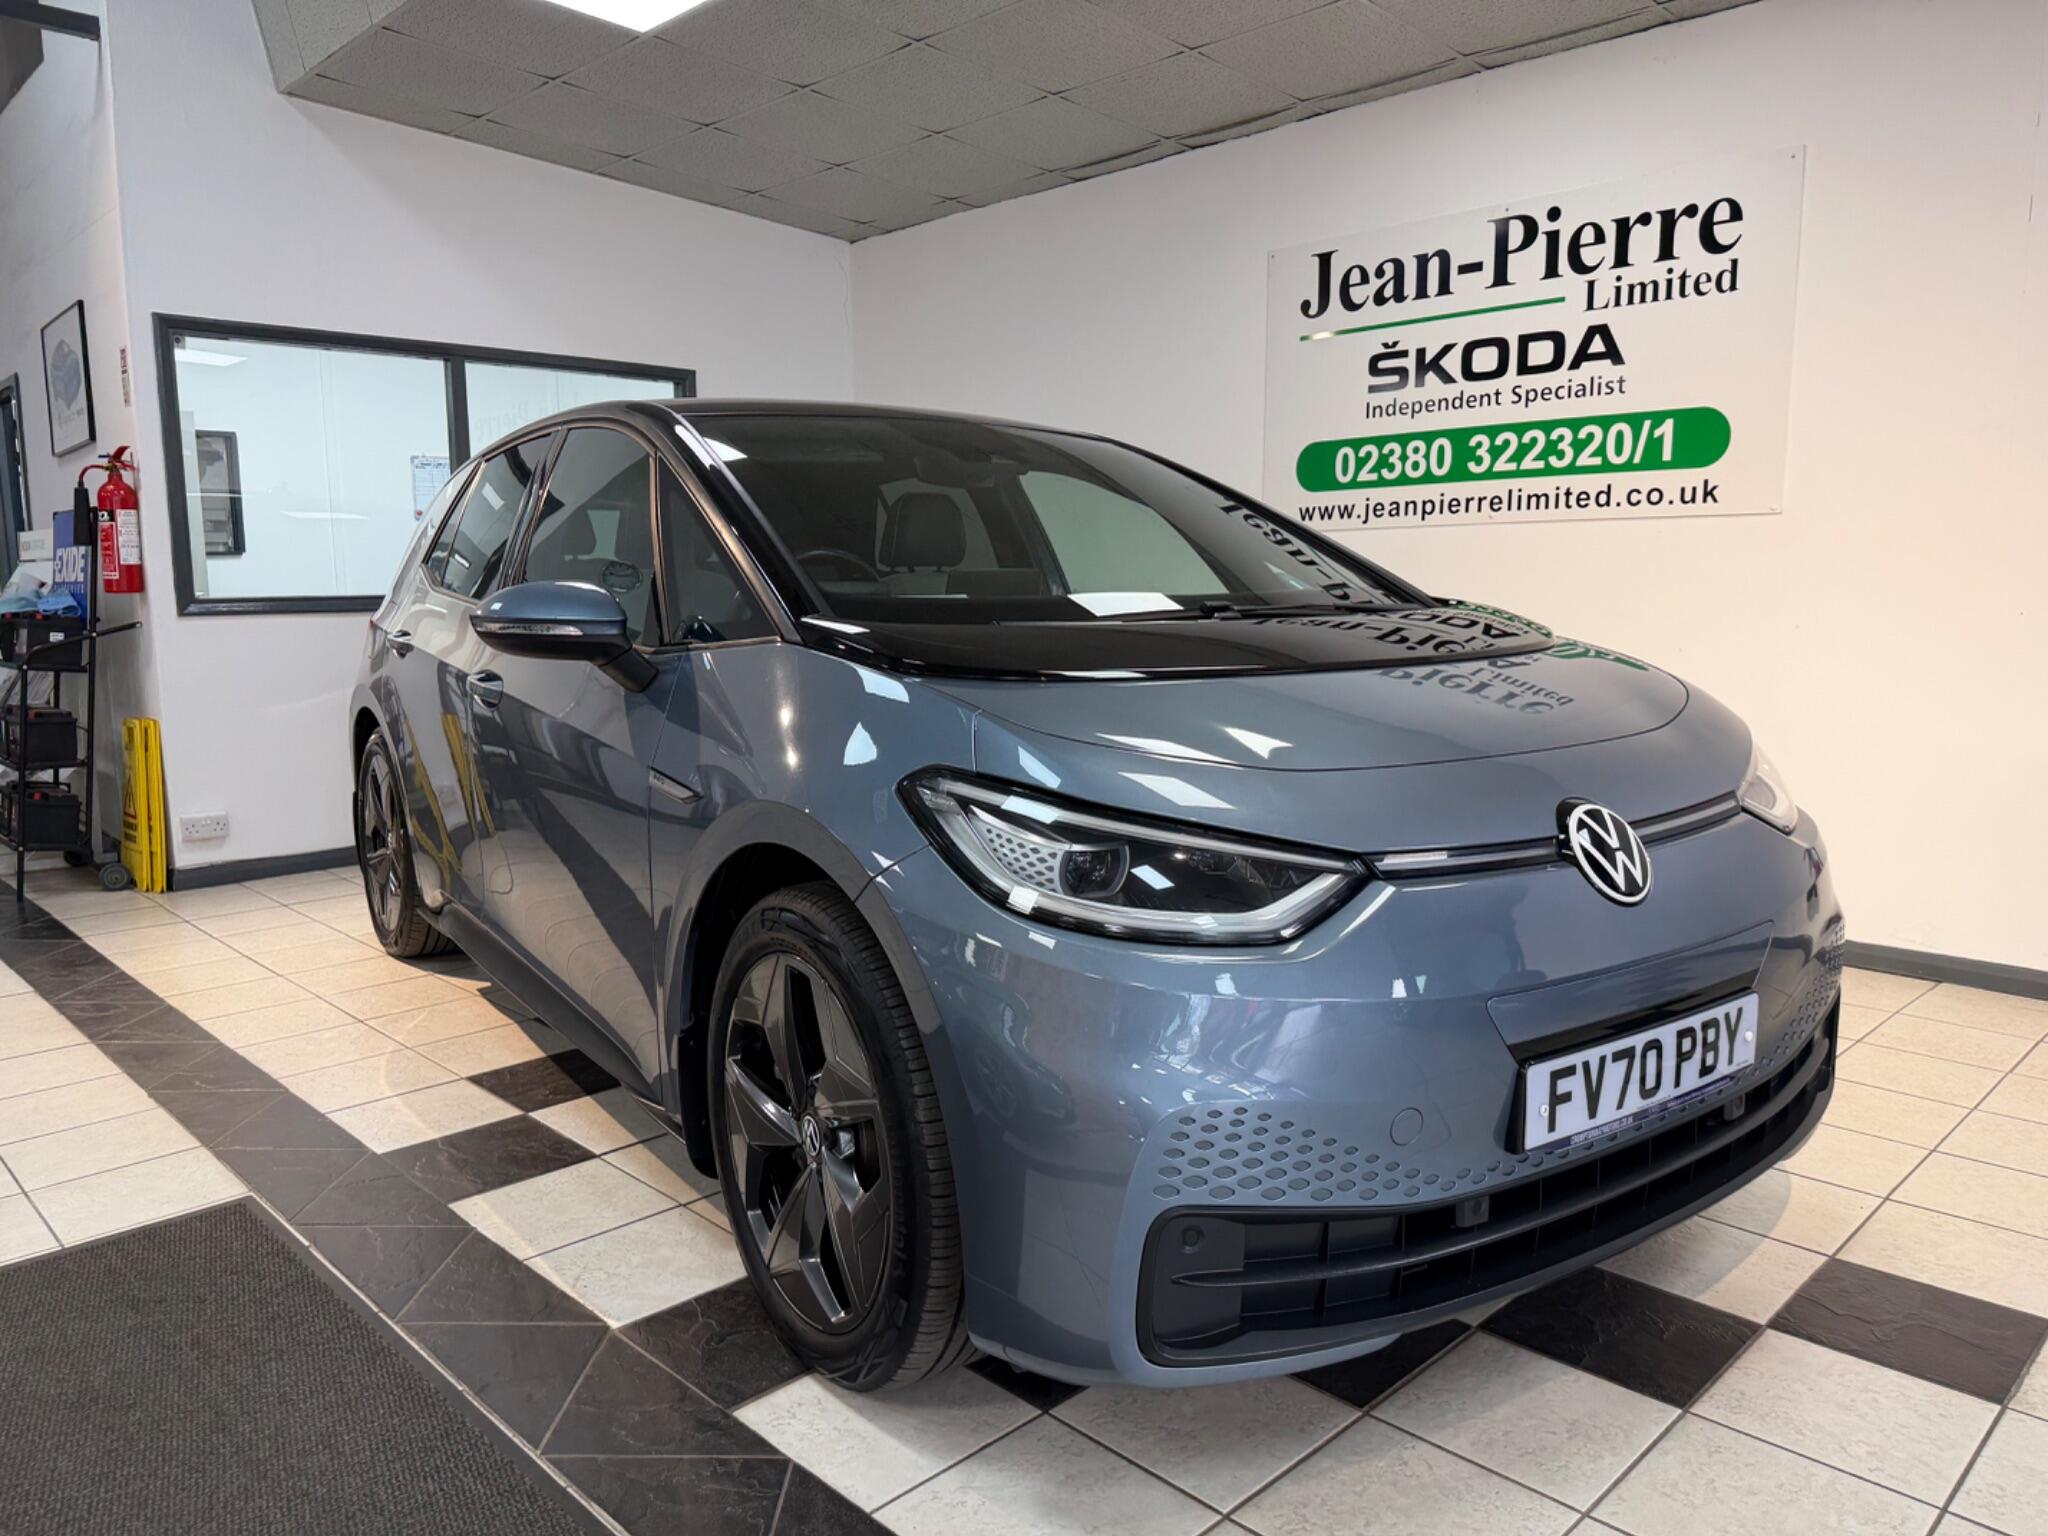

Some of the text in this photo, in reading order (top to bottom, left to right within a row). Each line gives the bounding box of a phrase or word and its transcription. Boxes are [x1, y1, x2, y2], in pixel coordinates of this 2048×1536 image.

[1300, 197, 1744, 319] Jean-Pierre
[1584, 258, 1740, 312] Limited
[1367, 323, 1626, 394] ŠKODA
[1365, 375, 1627, 419] Independent Specialist
[1334, 418, 1676, 484] 02380 322320/1
[1298, 478, 1720, 524] www.jeanpierrelimited.co.uk
[54, 546, 86, 582] EXIDE
[1547, 1037, 1663, 1133] FV70
[1674, 1006, 1744, 1089] PBY
